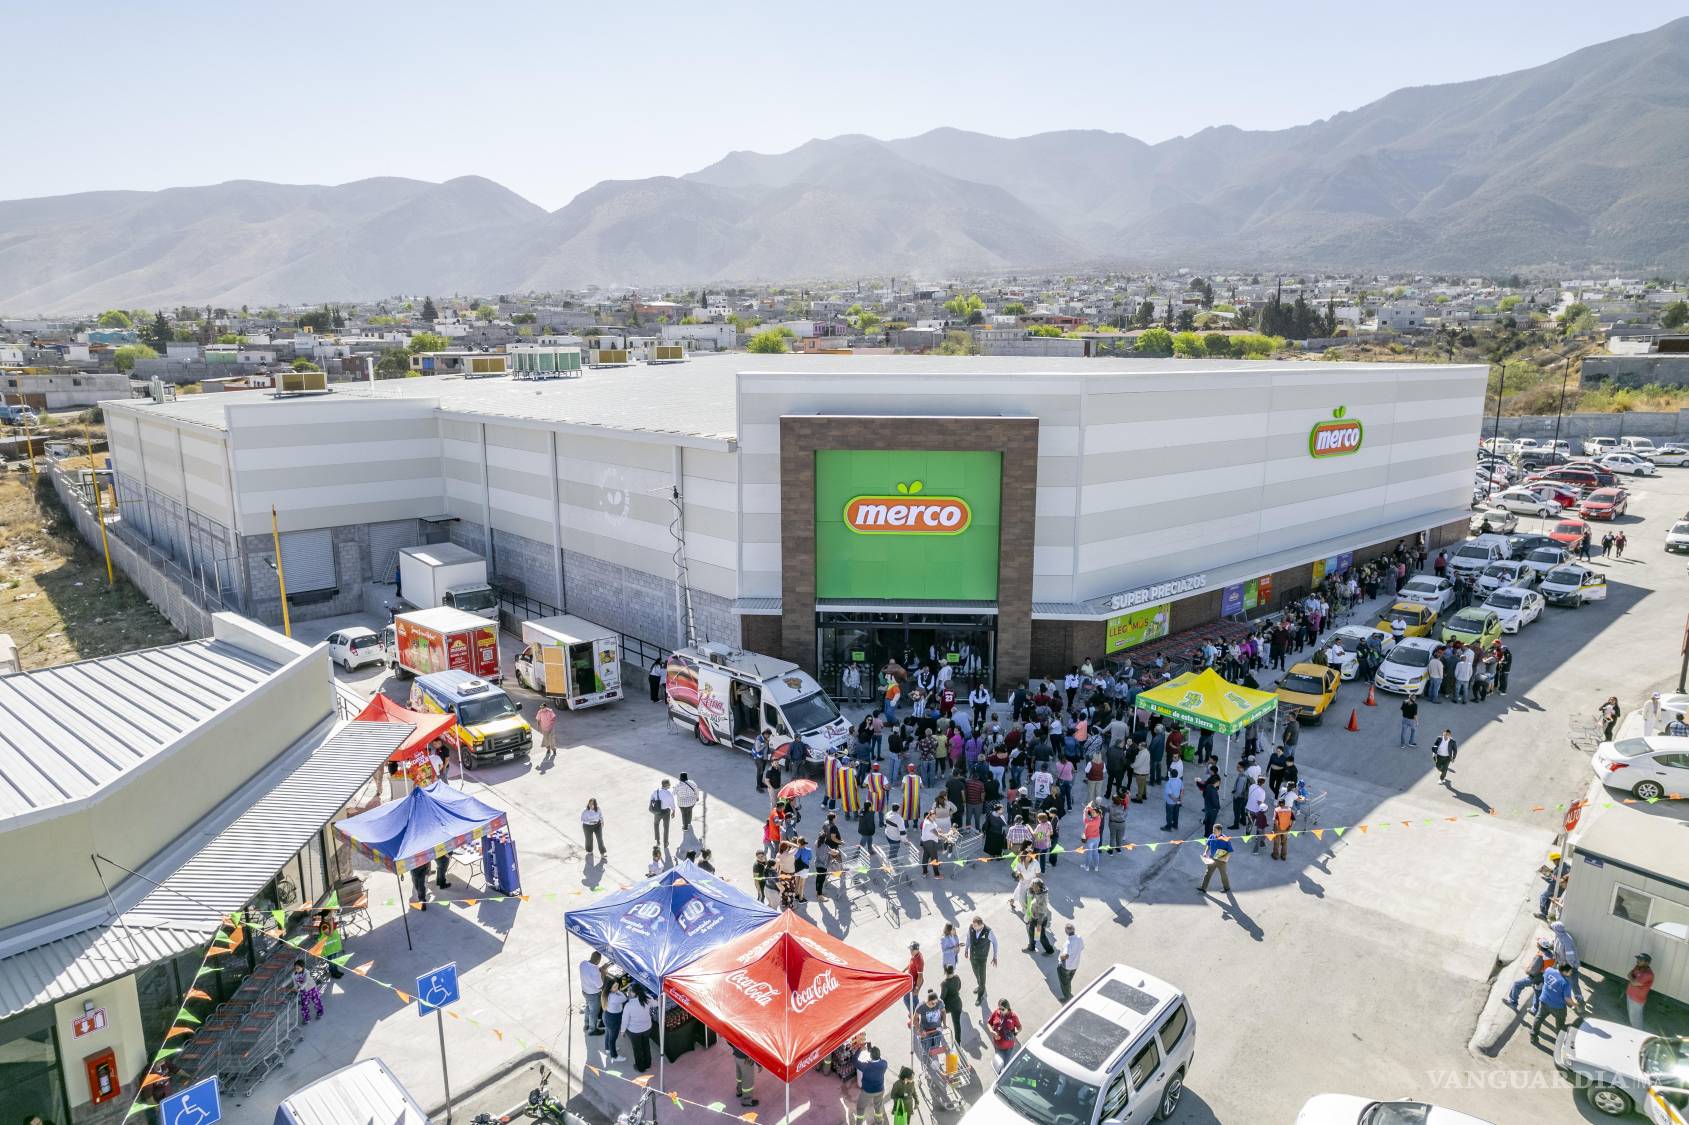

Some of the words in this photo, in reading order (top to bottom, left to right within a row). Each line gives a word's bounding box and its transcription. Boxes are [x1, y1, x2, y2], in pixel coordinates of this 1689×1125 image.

[1316, 428, 1360, 450] merco
[855, 504, 962, 527] merco
[1111, 588, 1149, 610] SUPER
[1151, 575, 1207, 600] PRECIAZOS
[1172, 710, 1180, 718] de
[1039, 784, 1045, 793] 2
[1566, 807, 1581, 824] ALTO
[627, 903, 661, 918] FUD
[678, 900, 705, 930] FUD
[725, 969, 782, 1007] Coca-Cola
[790, 968, 840, 1014] Coca-Cola
